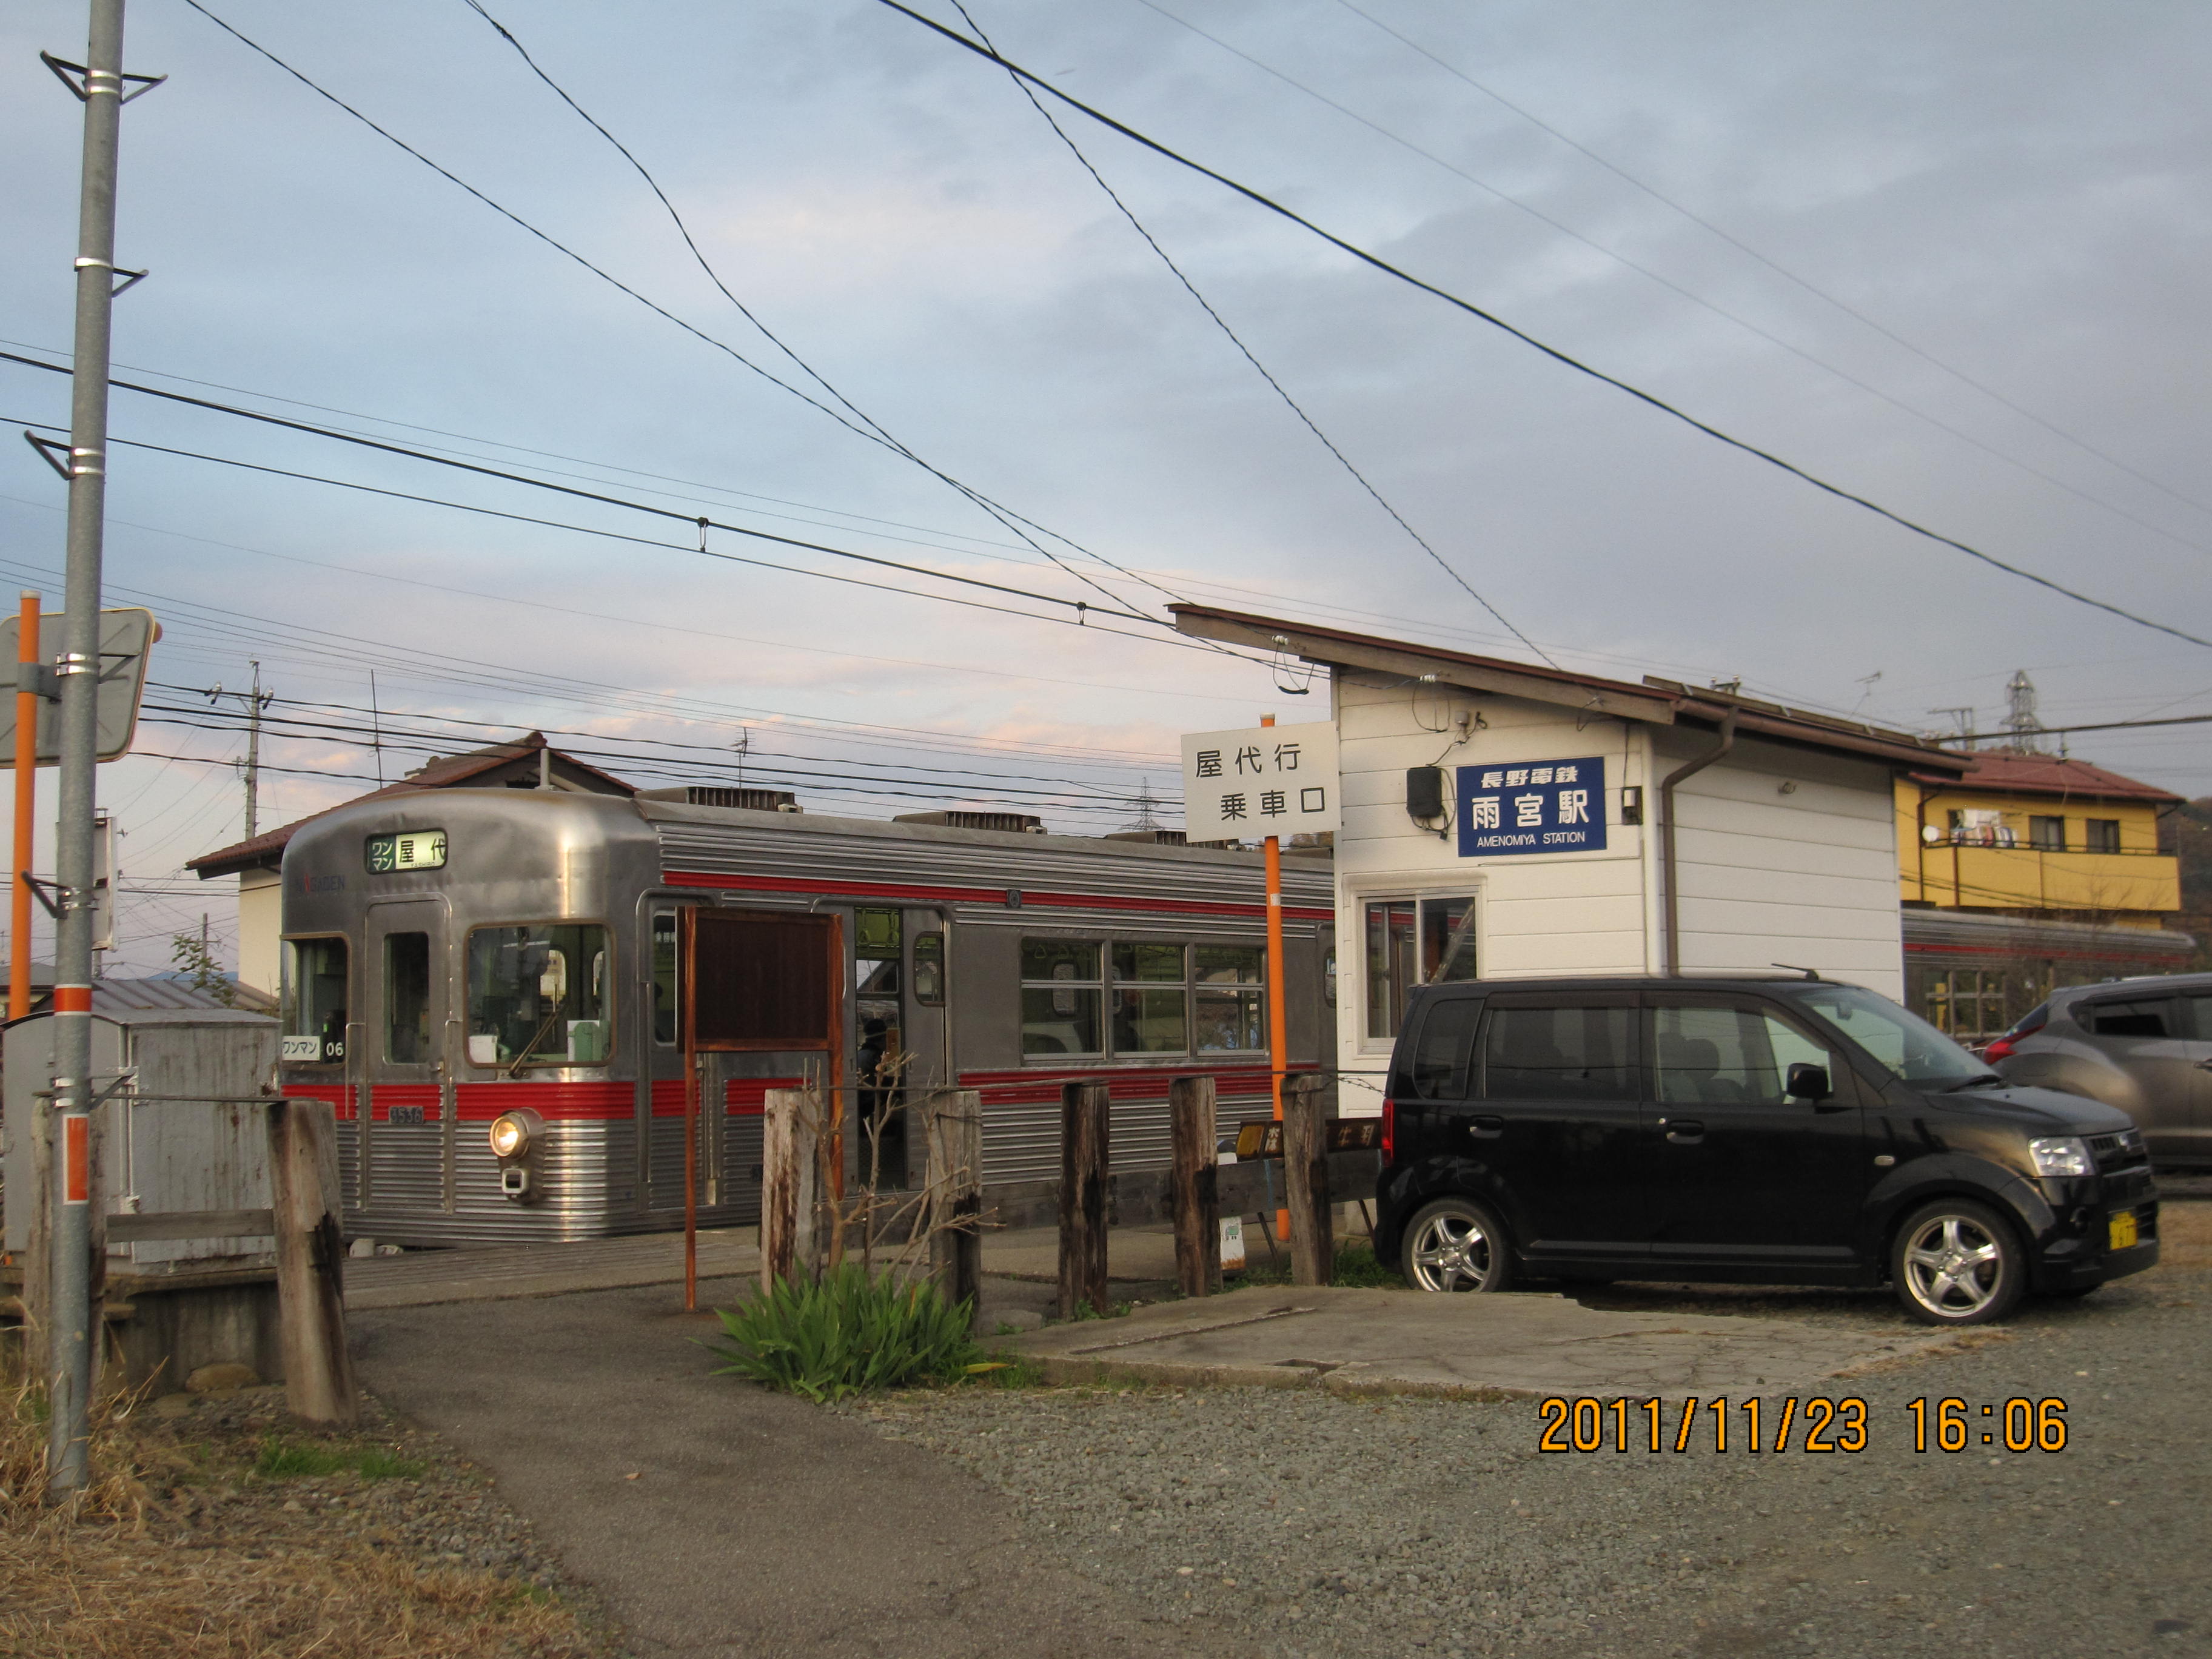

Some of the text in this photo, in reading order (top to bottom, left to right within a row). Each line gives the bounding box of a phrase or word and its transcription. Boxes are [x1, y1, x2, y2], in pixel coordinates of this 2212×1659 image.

[1195, 743, 1301, 778] 屋代行
[1481, 765, 1579, 789] 長野電鉄
[1220, 787, 1326, 821] 乗車口
[1471, 789, 1590, 830] 雨宮駅
[400, 838, 446, 863] 屋代
[1476, 831, 1586, 848] AMENOMIYA STATION
[282, 1041, 317, 1054] ワンマン
